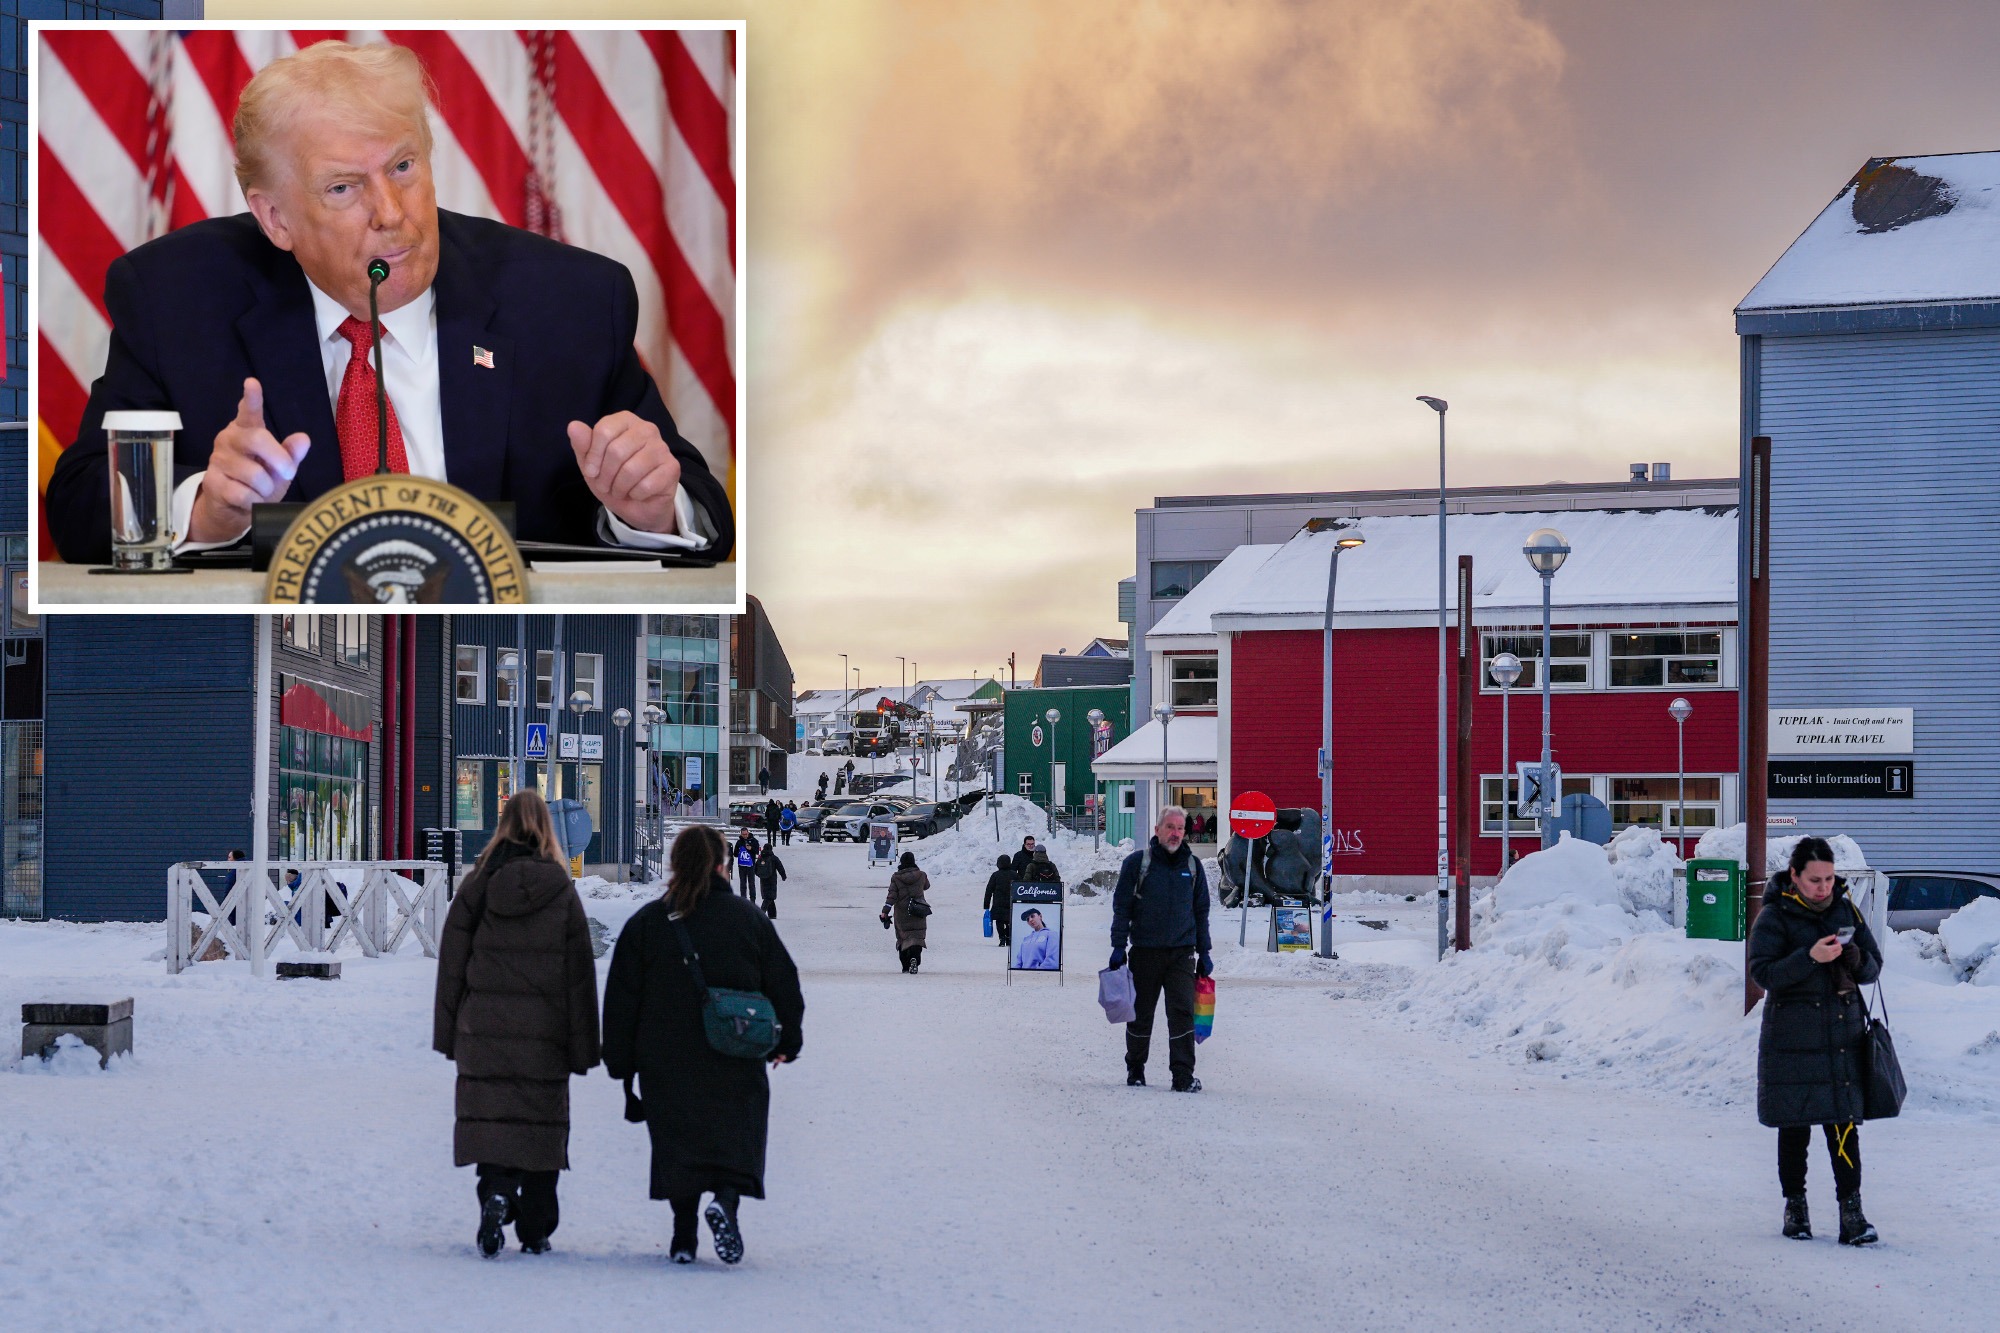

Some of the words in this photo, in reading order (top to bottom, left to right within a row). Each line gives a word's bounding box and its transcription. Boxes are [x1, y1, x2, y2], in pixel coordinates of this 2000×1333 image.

[274, 485, 388, 602] PRESIDENT
[397, 488, 420, 504] OF
[427, 493, 459, 519] THE
[464, 515, 522, 603] UNITE
[1778, 716, 1825, 726] TUPILAK
[1833, 717, 1851, 725] Inuit
[1852, 717, 1871, 726] Craft
[1871, 717, 1885, 725] and
[1886, 717, 1904, 725] Furs
[1796, 734, 1842, 744] TUPILAK
[1844, 734, 1885, 744] TRAVEL
[1773, 773, 1812, 784] Tourist
[1815, 773, 1882, 784] information
[1016, 885, 1058, 898] California
